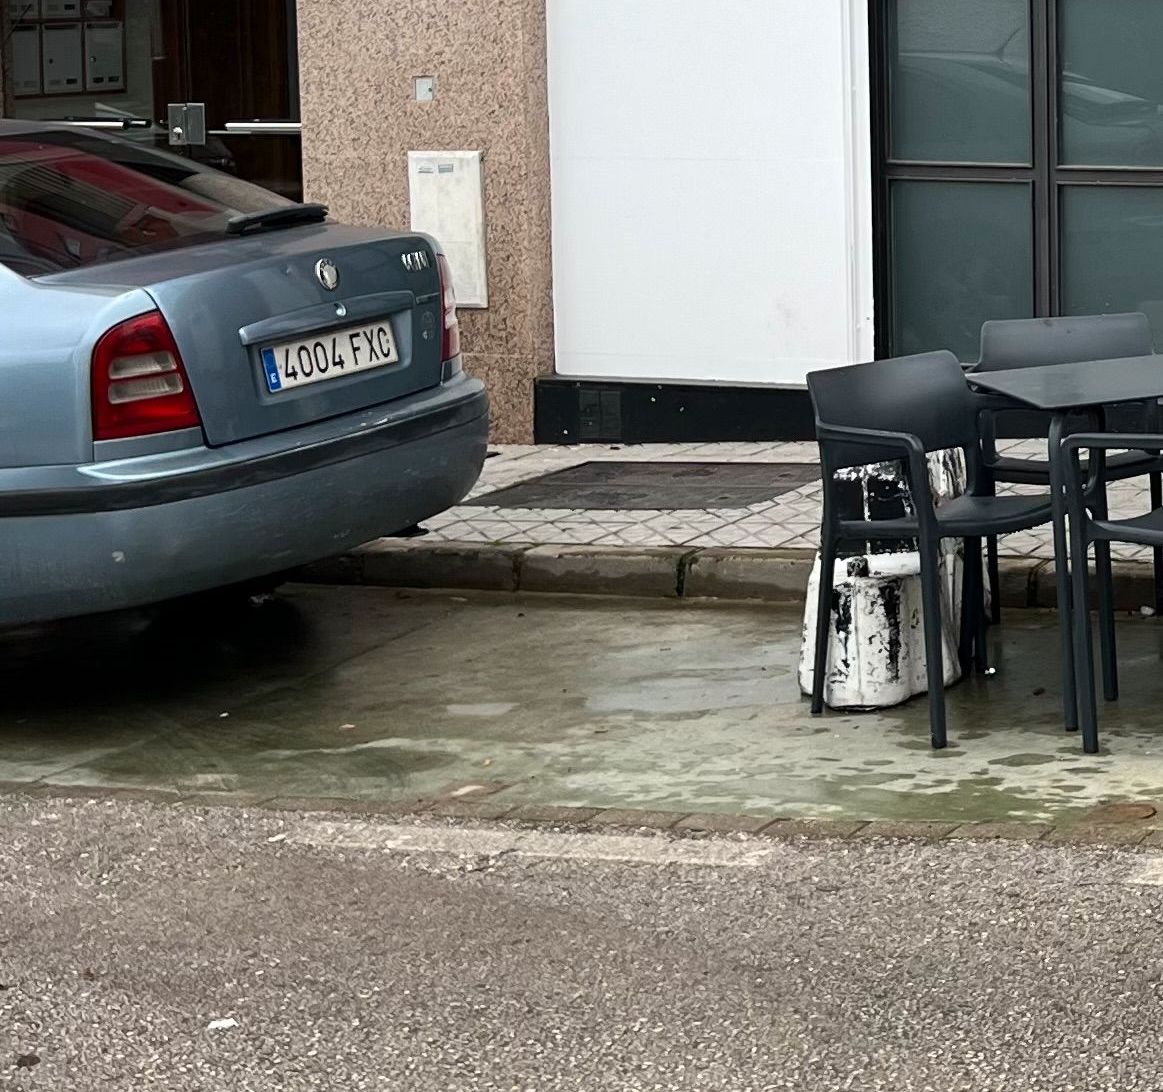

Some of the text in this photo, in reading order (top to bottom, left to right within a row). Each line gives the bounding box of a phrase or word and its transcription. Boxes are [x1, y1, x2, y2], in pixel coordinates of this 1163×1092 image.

[285, 326, 391, 381] 4004 FXC
[270, 373, 278, 383] E
